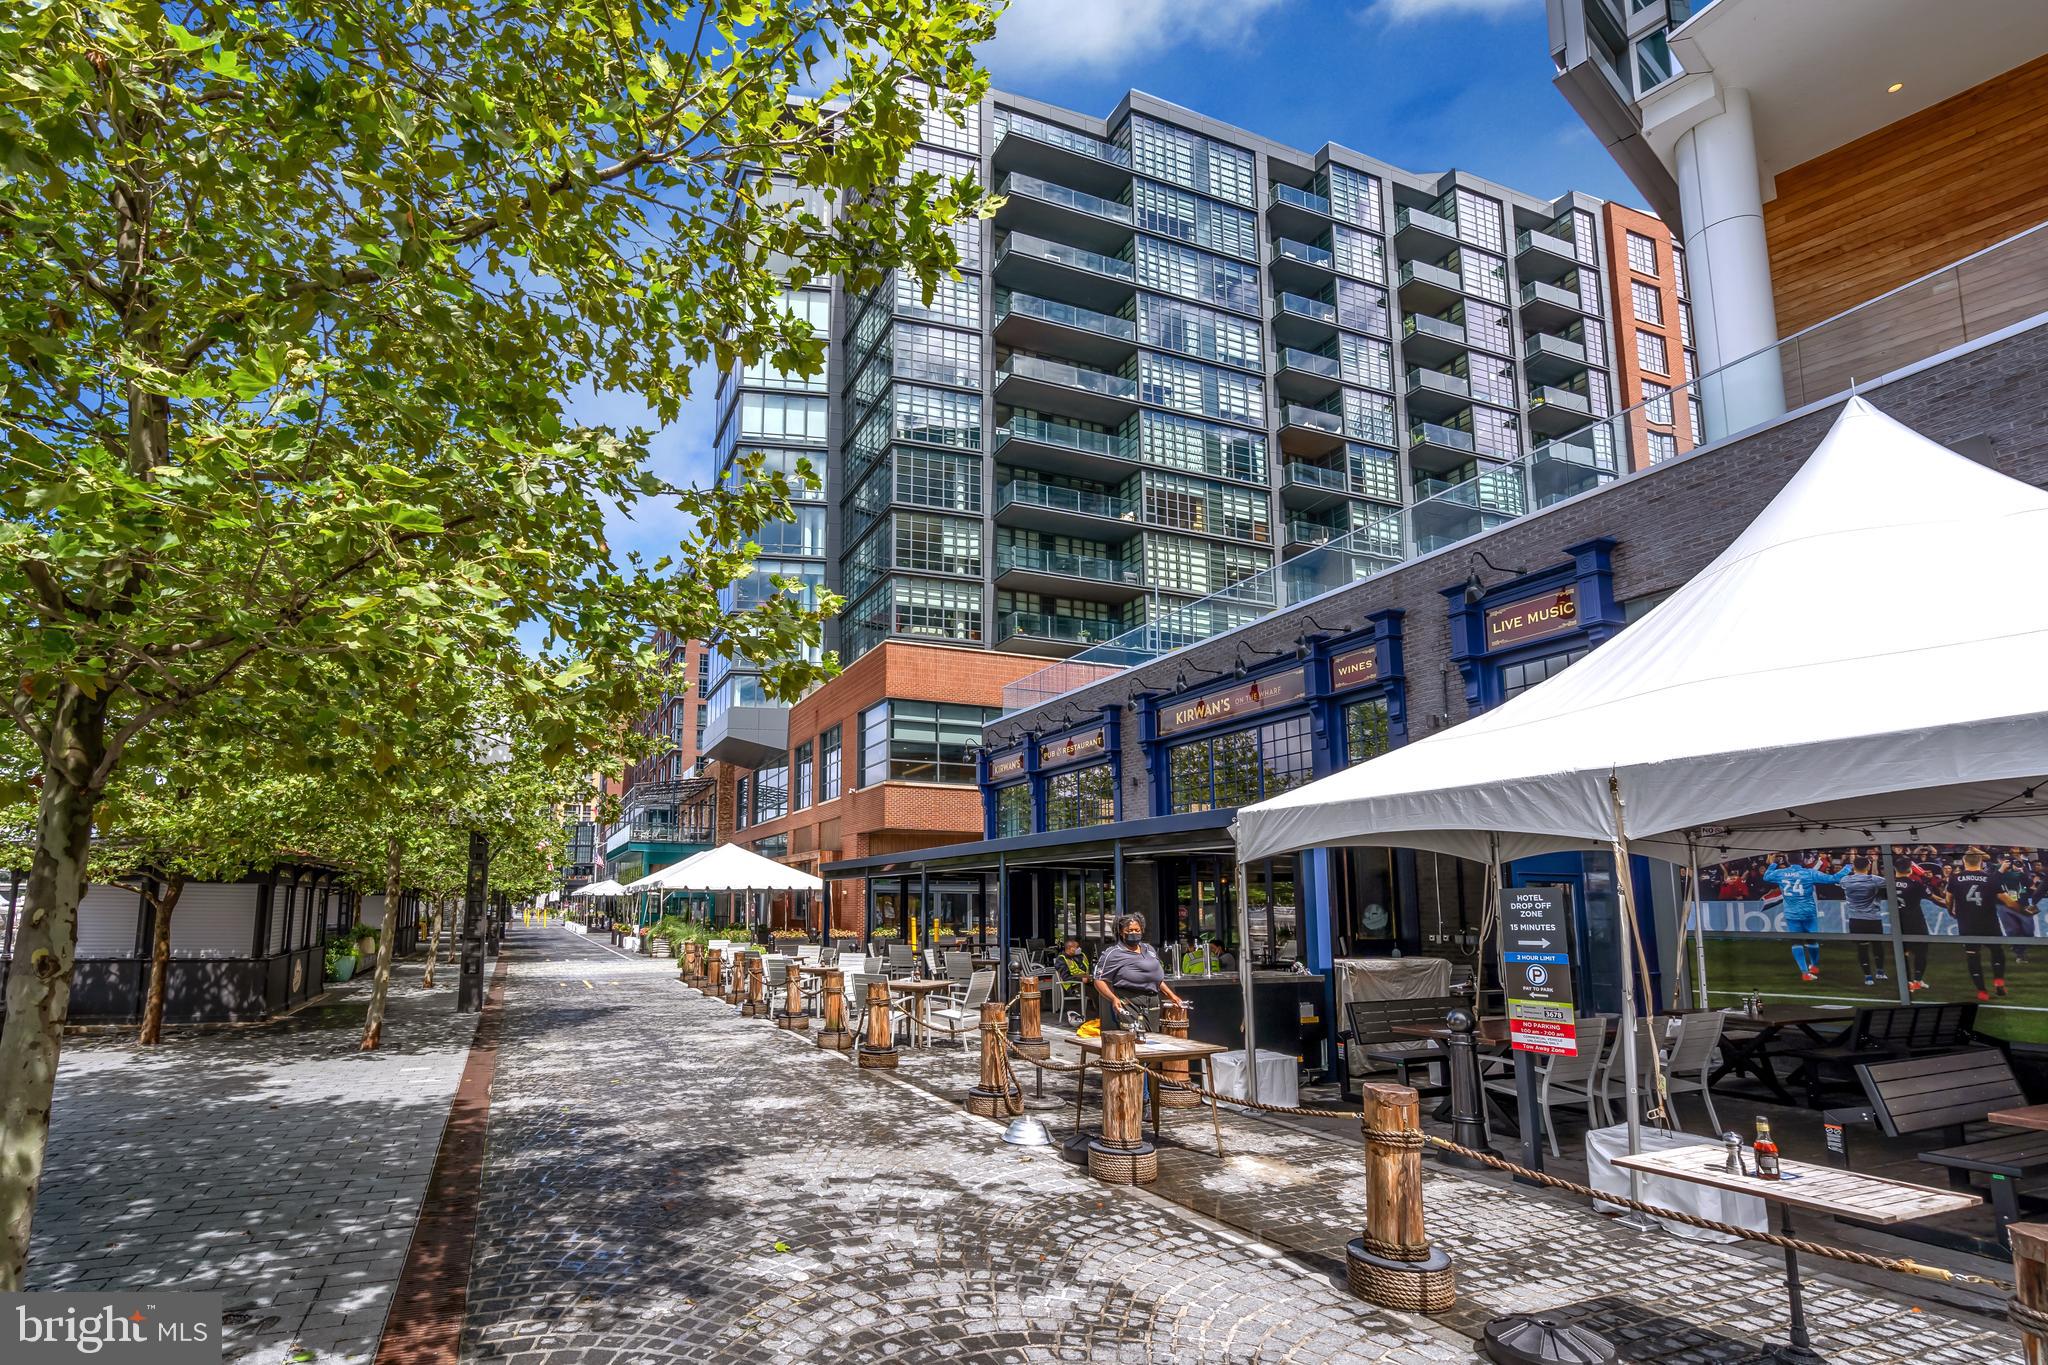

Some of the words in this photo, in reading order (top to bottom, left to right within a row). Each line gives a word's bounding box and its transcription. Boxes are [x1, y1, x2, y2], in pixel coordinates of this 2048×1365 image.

[1493, 616, 1523, 633] LIVE
[1527, 602, 1574, 624] MUSIC
[1338, 660, 1373, 675] WINES
[1176, 697, 1231, 725] KIRWAN'S
[1234, 697, 1244, 705] ON
[1245, 692, 1258, 702] THE
[1258, 686, 1281, 698] WHARF
[1043, 750, 1056, 759] PUB
[1062, 737, 1102, 755] RESTAURANT
[1782, 879, 1805, 896] 24
[1966, 884, 1983, 906] 4
[1703, 902, 1825, 931] Ube
[1532, 968, 1543, 981] P
